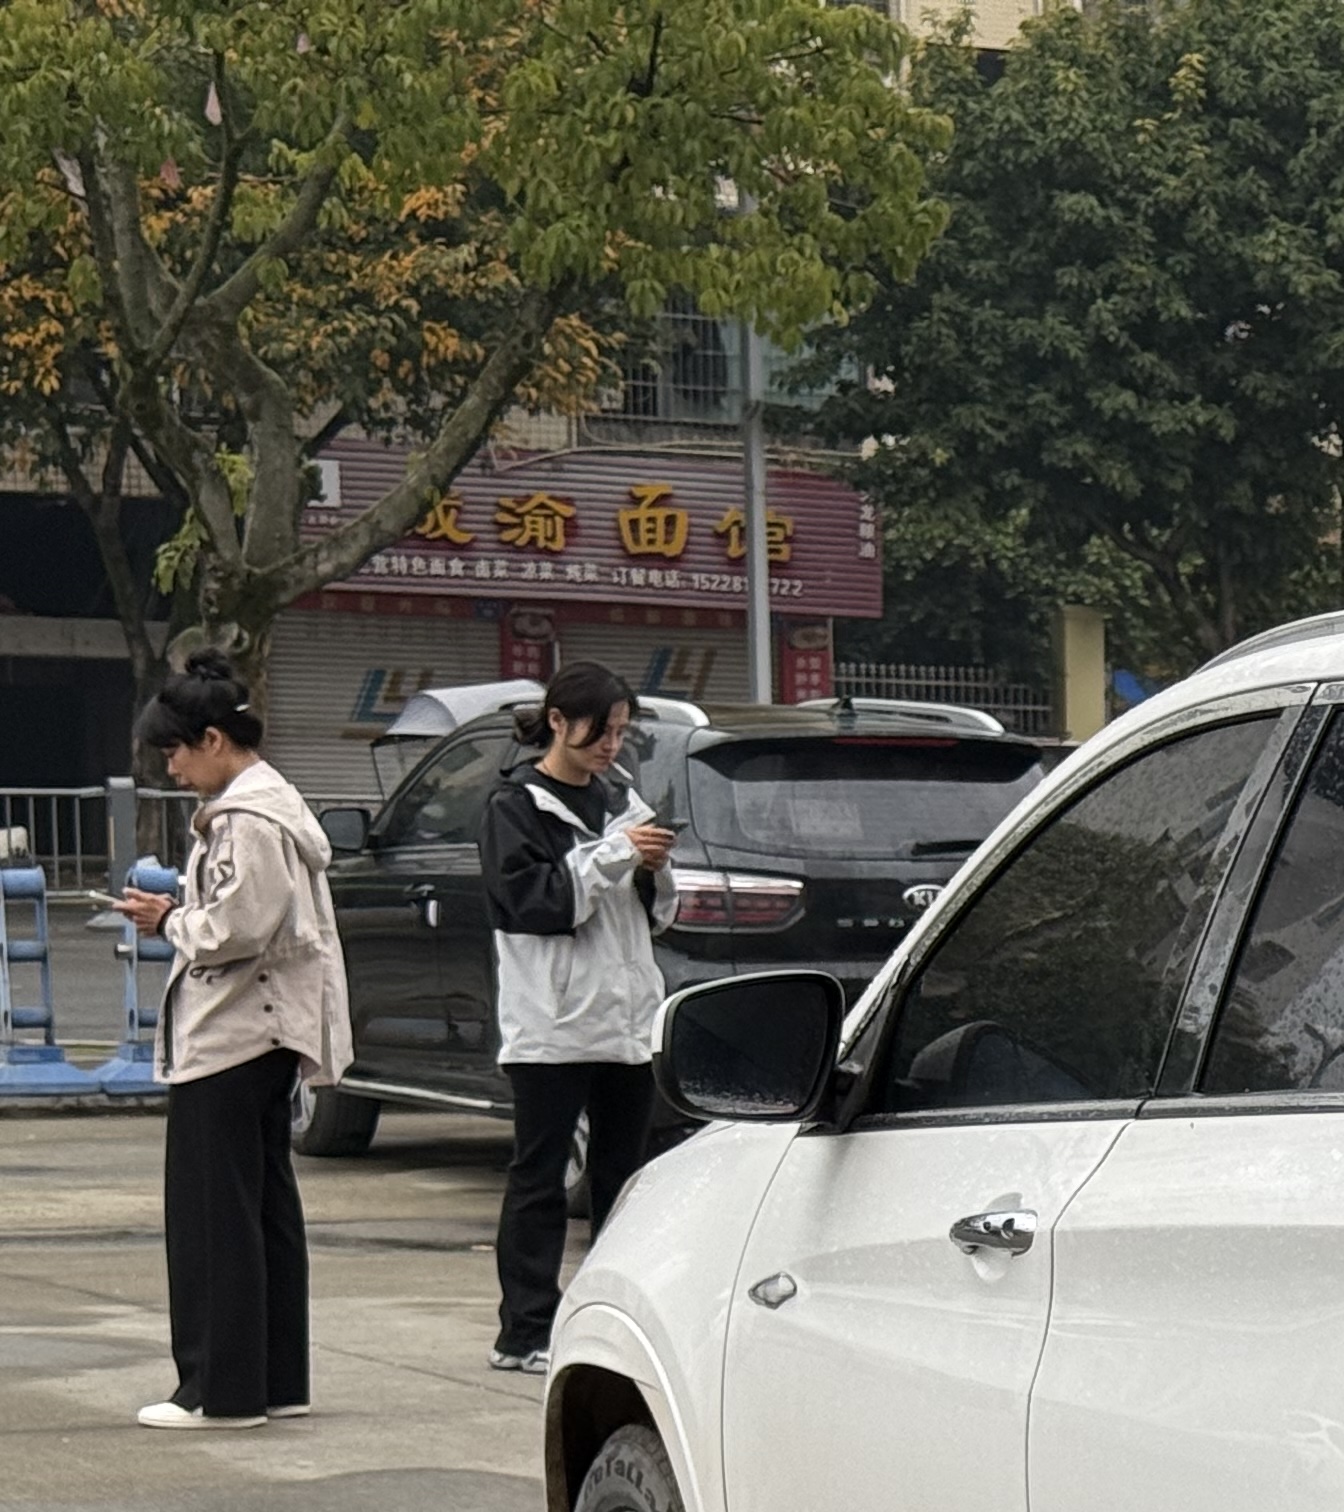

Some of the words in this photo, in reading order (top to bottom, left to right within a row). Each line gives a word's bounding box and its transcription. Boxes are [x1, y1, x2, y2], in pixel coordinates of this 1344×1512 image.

[359, 554, 465, 578] 营特色面食
